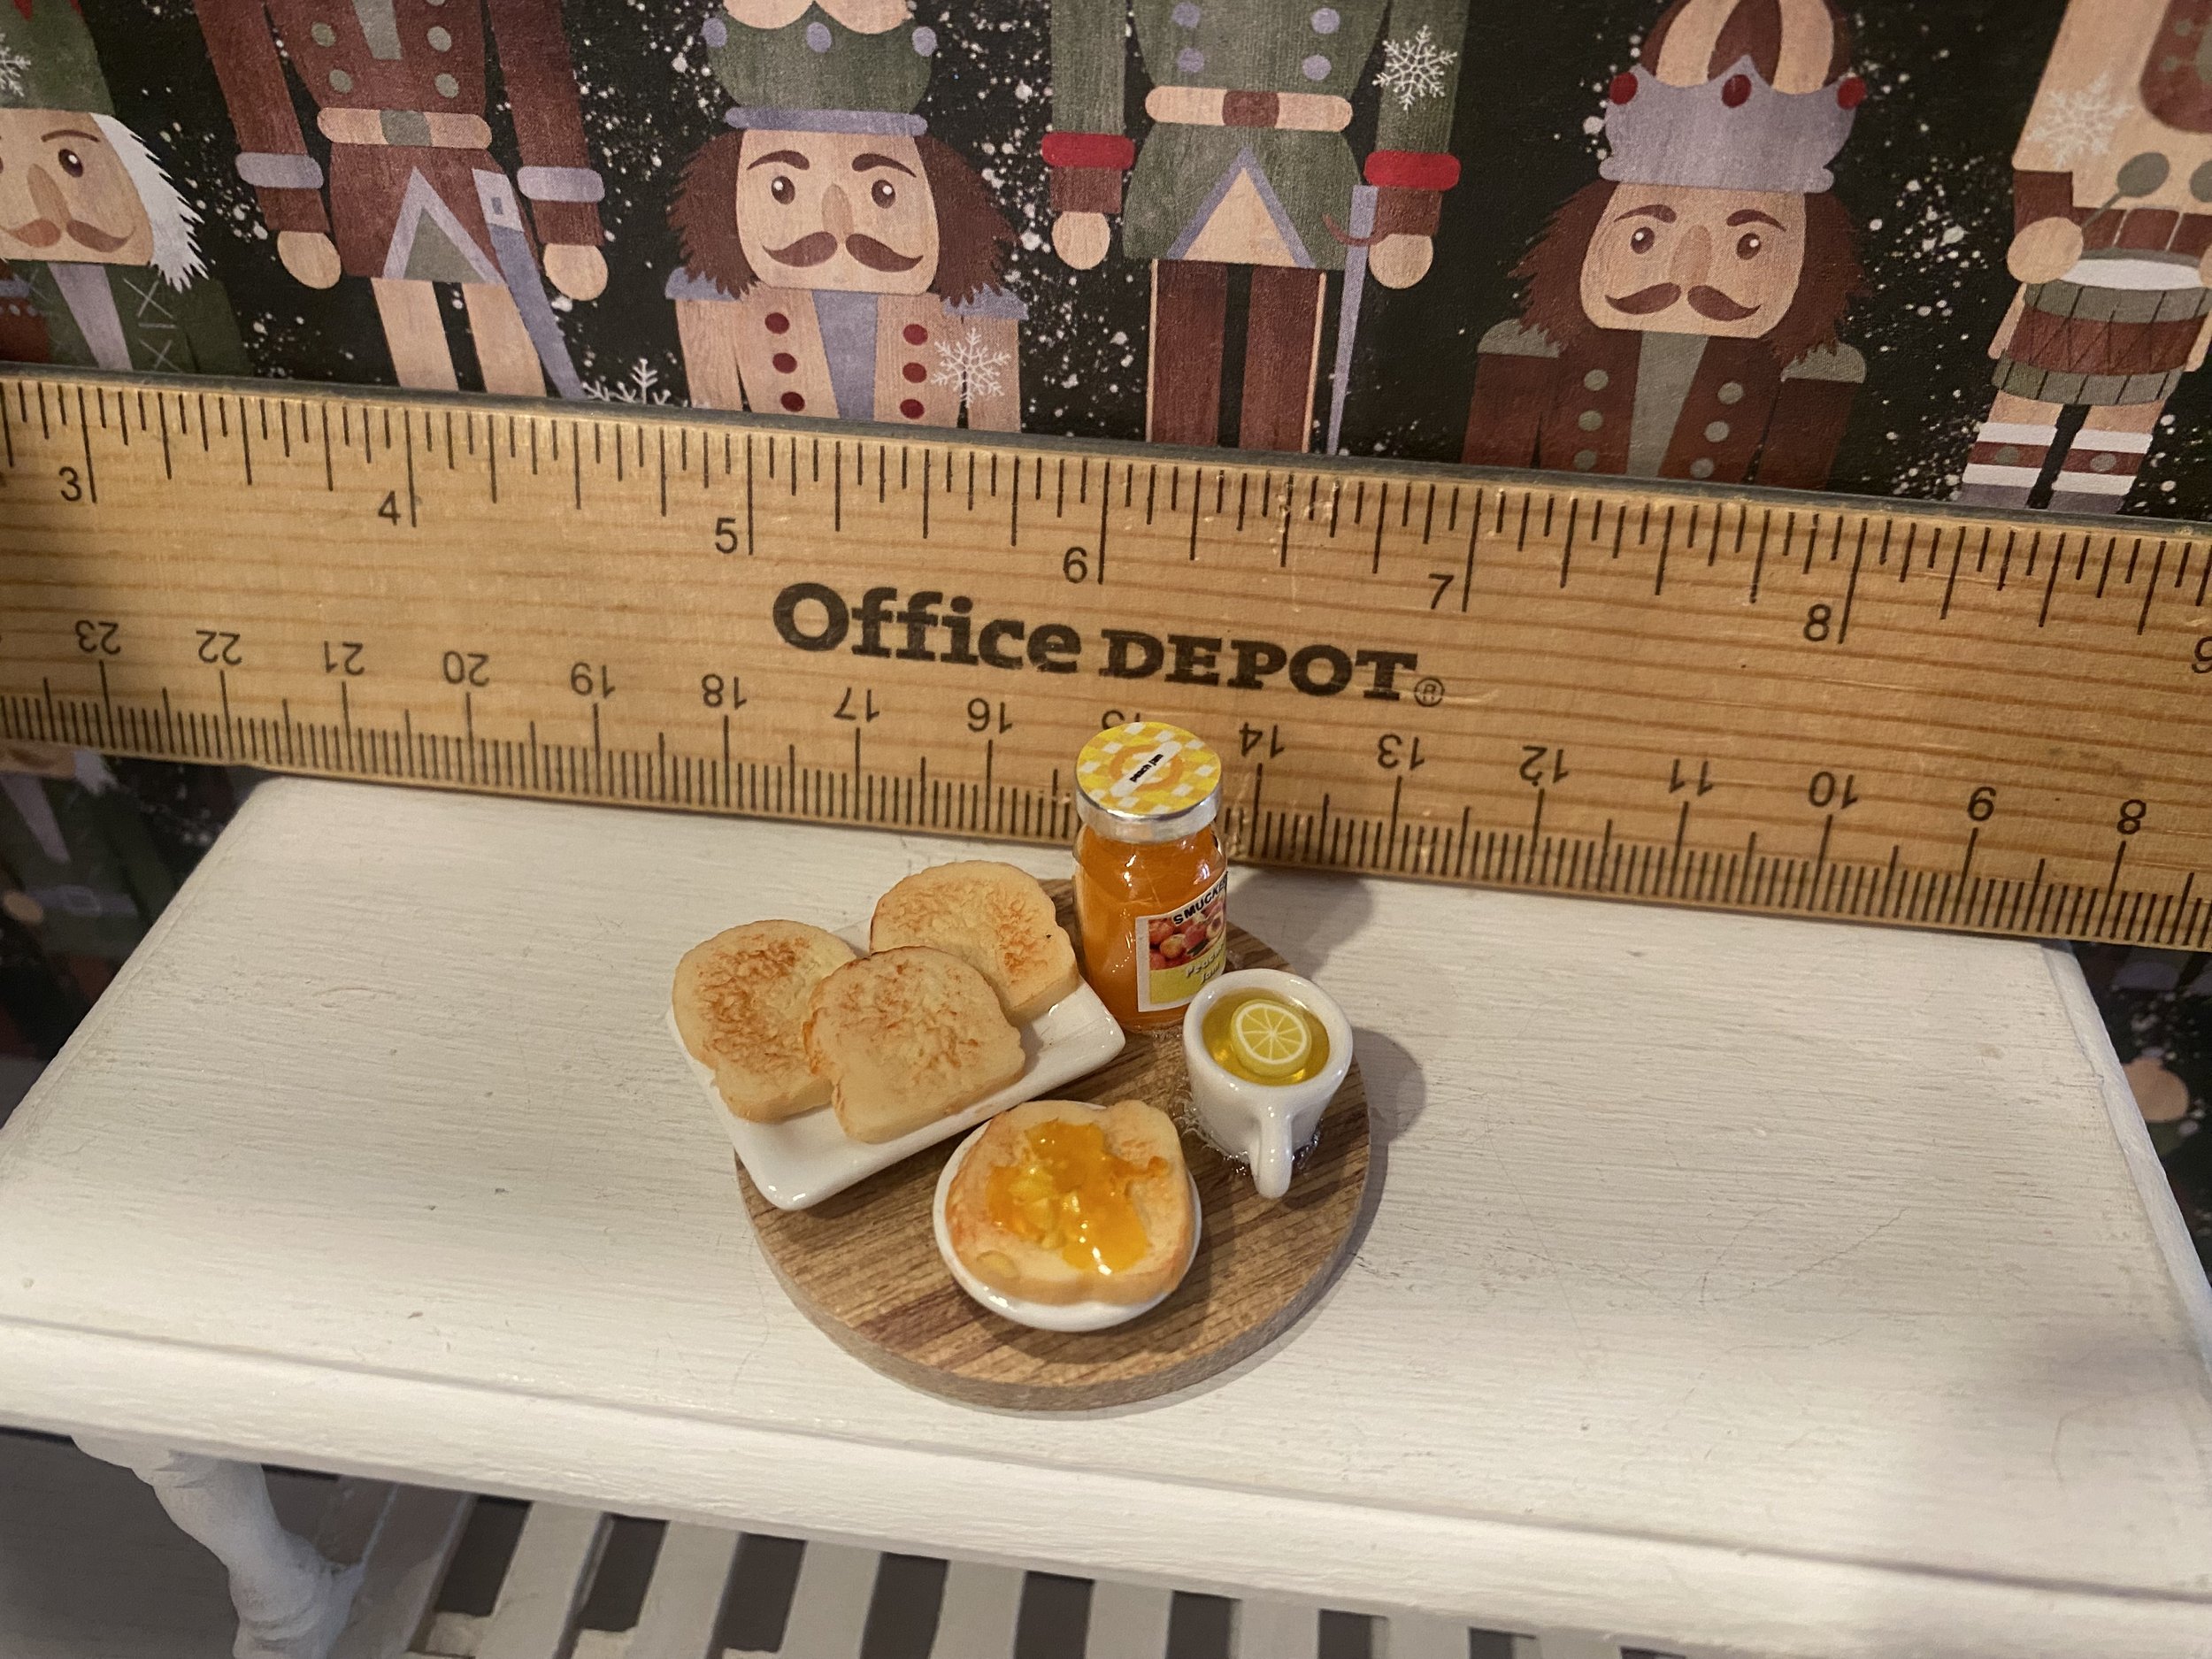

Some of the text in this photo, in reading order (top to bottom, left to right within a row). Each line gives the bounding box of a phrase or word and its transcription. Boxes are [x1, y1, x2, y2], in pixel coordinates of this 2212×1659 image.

[59, 466, 82, 502] 3
[378, 491, 401, 526] 4
[715, 518, 738, 555] 5
[1063, 546, 1088, 584] 6
[1428, 573, 1455, 611] 7
[1803, 603, 1832, 642] 8
[74, 619, 121, 655] 23
[772, 581, 1082, 675] Office
[196, 629, 242, 665] 22
[323, 641, 365, 677] 21
[442, 651, 490, 687] 20
[570, 661, 616, 698] 19
[701, 673, 748, 710] 18
[833, 687, 880, 723] 17
[967, 697, 1013, 734] 16
[1239, 722, 1286, 759] 14
[1377, 733, 1425, 771] 13
[1519, 746, 1570, 784] 12
[1669, 758, 1715, 797] 11
[1808, 771, 1859, 810] 10
[1966, 787, 1997, 821] 9
[2116, 799, 2147, 834] 8
